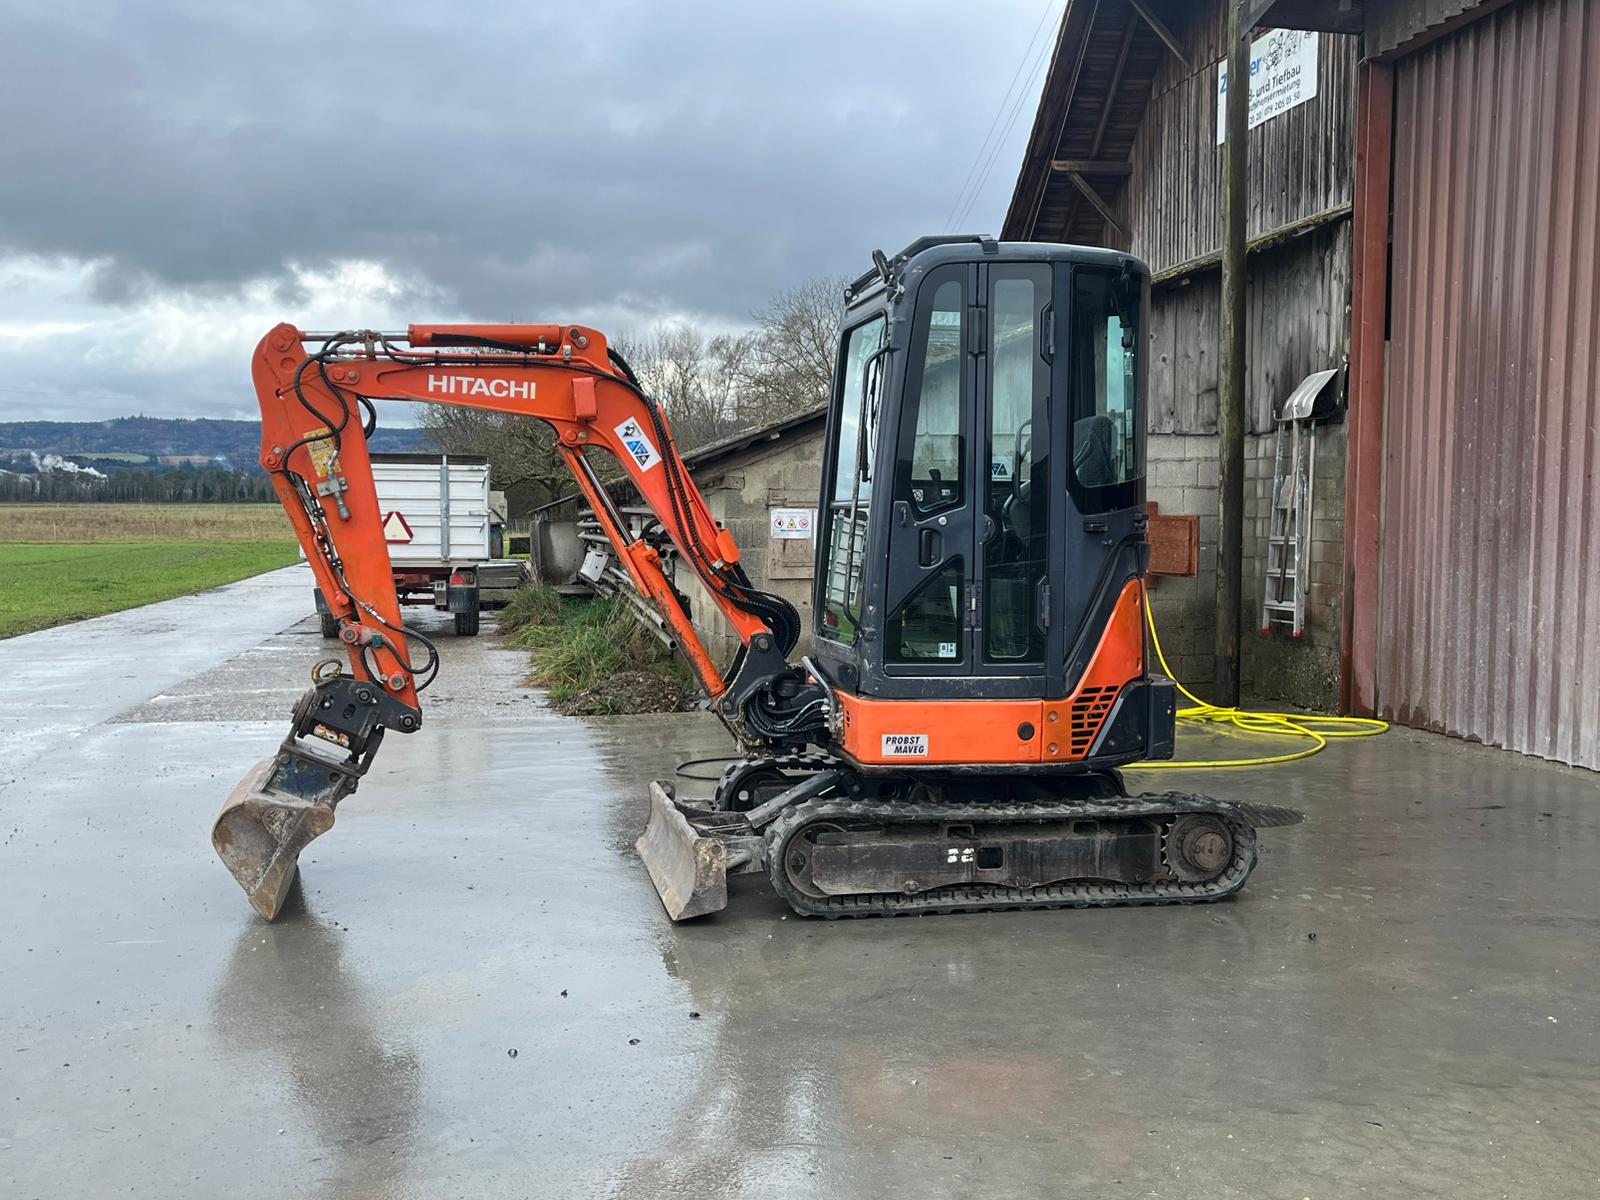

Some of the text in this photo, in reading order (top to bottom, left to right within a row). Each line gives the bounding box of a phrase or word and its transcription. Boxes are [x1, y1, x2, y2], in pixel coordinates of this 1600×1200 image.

[1256, 79, 1271, 98] und
[1272, 65, 1301, 88] Tiefbau
[428, 374, 536, 400] HITACHI
[885, 736, 921, 745] PROBST
[894, 745, 925, 754] MAVEG
